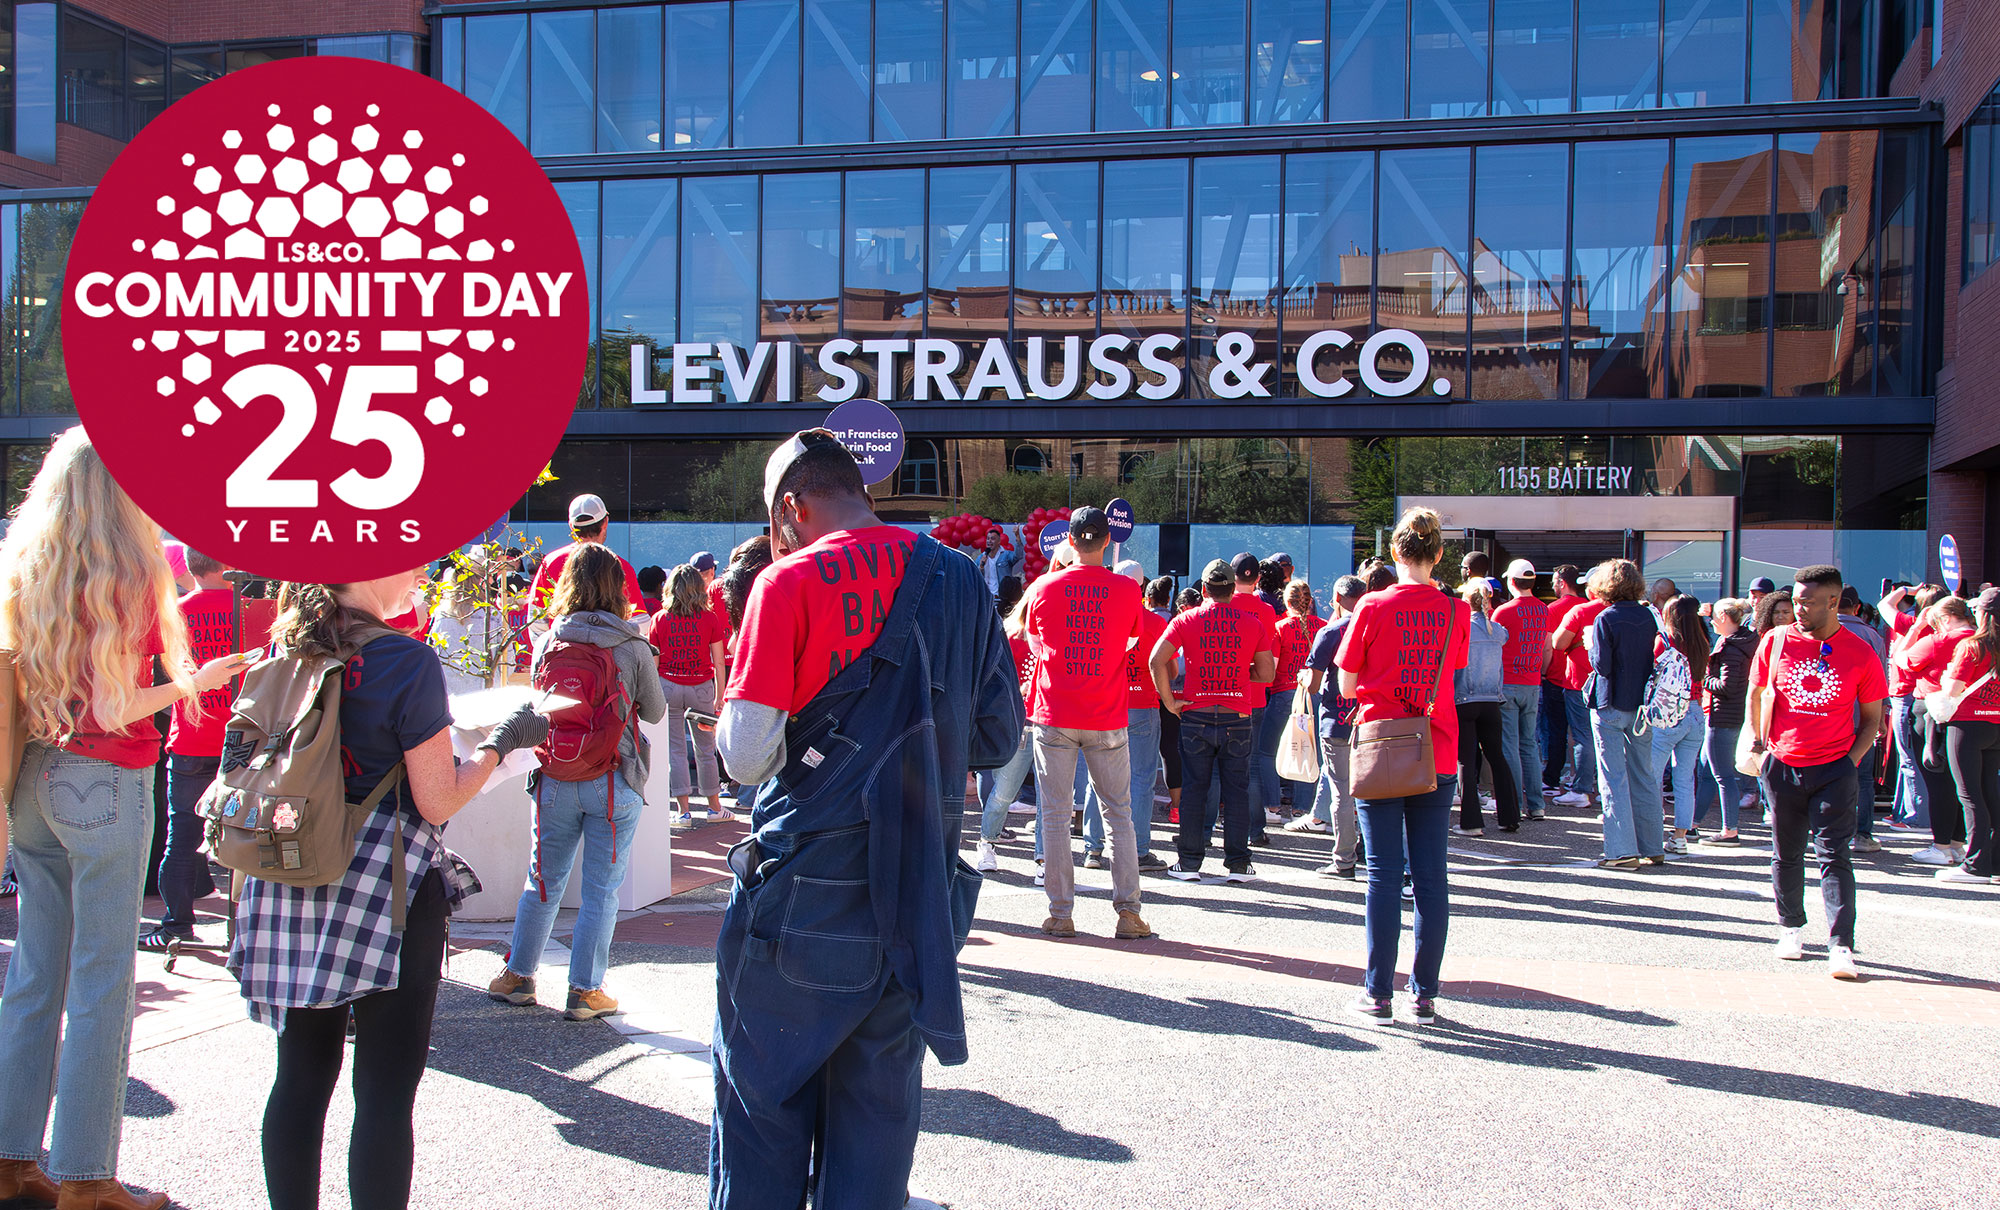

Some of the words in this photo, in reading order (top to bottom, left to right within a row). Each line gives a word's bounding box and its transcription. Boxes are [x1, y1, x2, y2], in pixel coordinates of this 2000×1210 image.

[631, 341, 795, 403] LEVI
[817, 334, 1184, 403] STRAUSS
[1209, 331, 1273, 399] &
[1296, 329, 1452, 398] CO.
[848, 429, 898, 440] Francisco
[866, 442, 892, 452] Food
[1498, 466, 1541, 489] 1155
[1548, 466, 1633, 489] BATTERY
[1113, 508, 1128, 519] Root
[1107, 517, 1132, 530] Division
[1043, 534, 1061, 543] Starr
[814, 540, 917, 585] GIVIN
[1065, 585, 1109, 599] GIVING
[842, 588, 887, 637] BA
[1070, 599, 1102, 613] BACK
[1066, 615, 1105, 629] NEVER
[1289, 619, 1320, 629] GING
[1395, 611, 1445, 627] GIVING
[1523, 617, 1547, 629] BACK
[670, 622, 698, 633] BACK
[1204, 620, 1238, 633] BACK
[194, 628, 232, 643] BACK
[668, 635, 701, 647] NEVER
[1069, 631, 1100, 645] GOES
[1402, 630, 1439, 646] BACK
[1200, 636, 1241, 649] NEVER
[1292, 643, 1309, 653] NEV
[191, 645, 232, 660] NEVE
[672, 648, 698, 660] GOES
[1064, 646, 1085, 660] OUT
[1089, 648, 1104, 660] OF
[1204, 651, 1237, 664] GOES
[1398, 650, 1441, 665] NEVER
[1293, 655, 1305, 664] GO
[1066, 662, 1104, 676] STYLE.
[1200, 666, 1222, 678] OUT
[1226, 666, 1240, 678] OF
[1401, 668, 1436, 684] GOES
[1394, 687, 1421, 702] OUT
[200, 695, 231, 708] STYL
